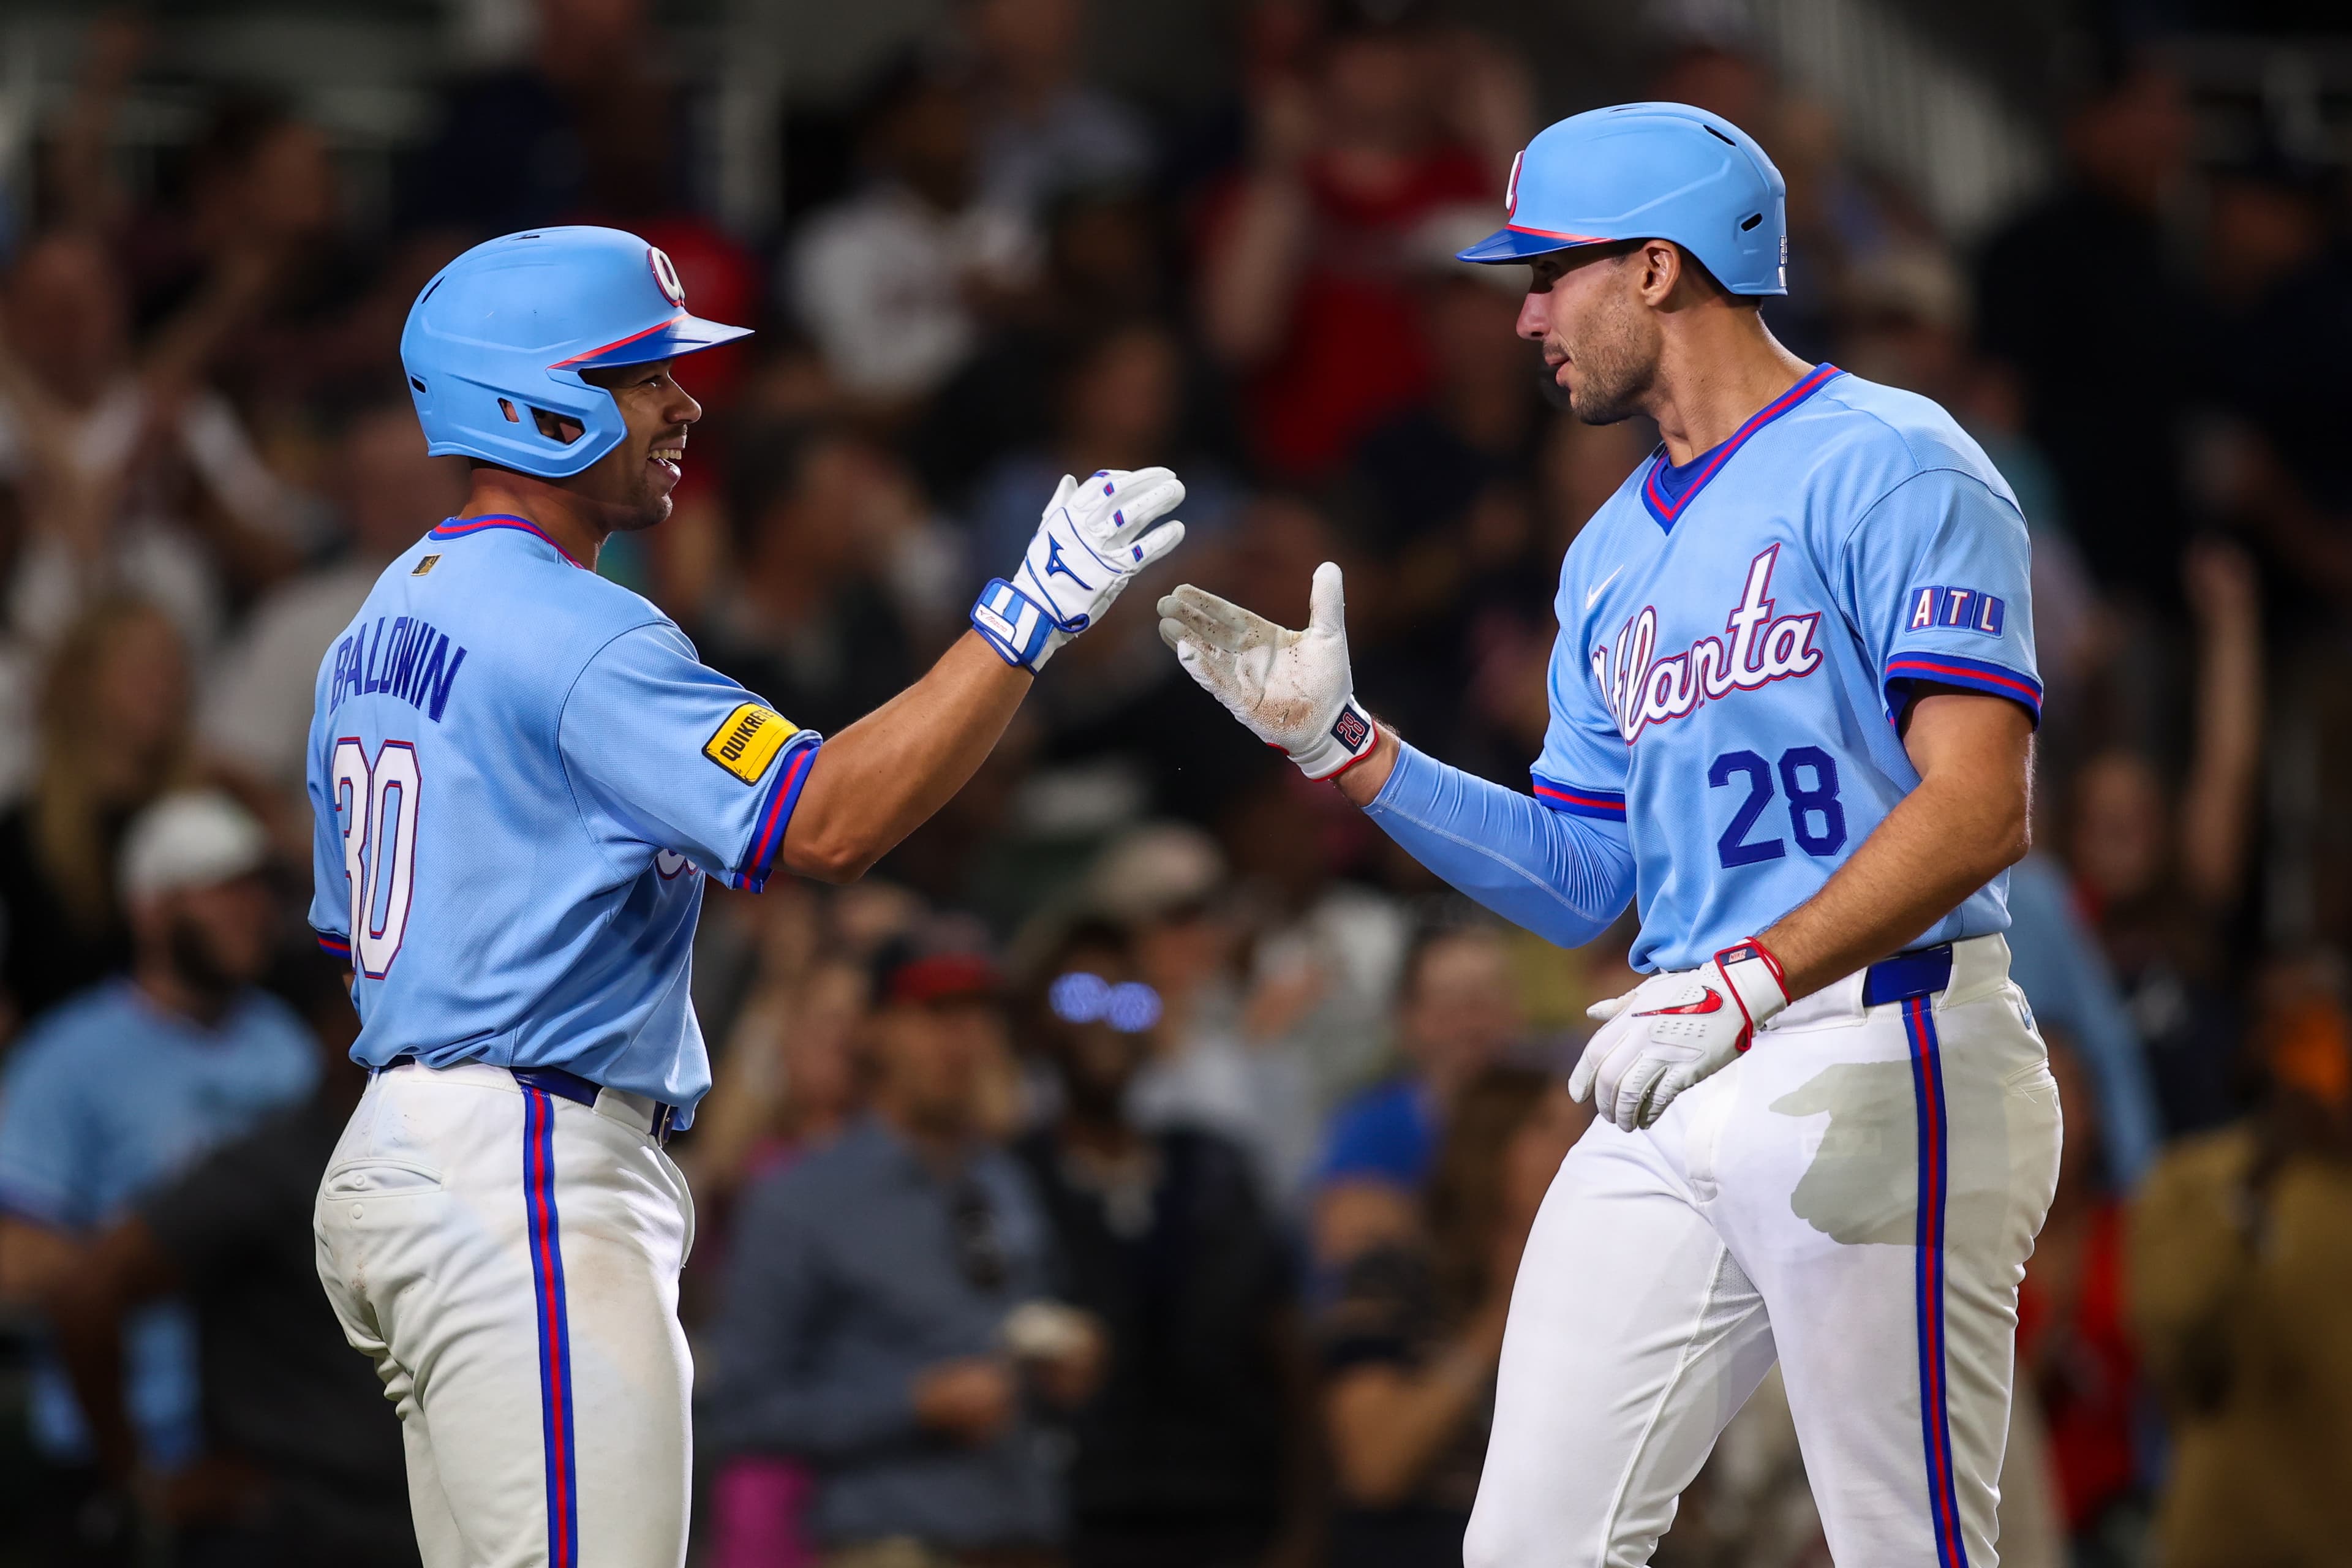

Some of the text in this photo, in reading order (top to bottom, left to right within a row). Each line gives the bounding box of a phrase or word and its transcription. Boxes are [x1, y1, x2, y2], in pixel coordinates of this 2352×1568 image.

[1912, 589, 1995, 632] ATL
[330, 616, 467, 723] BALDWIN
[1337, 712, 1365, 747] 28
[331, 736, 422, 980] 30
[1708, 745, 1847, 869] 28
